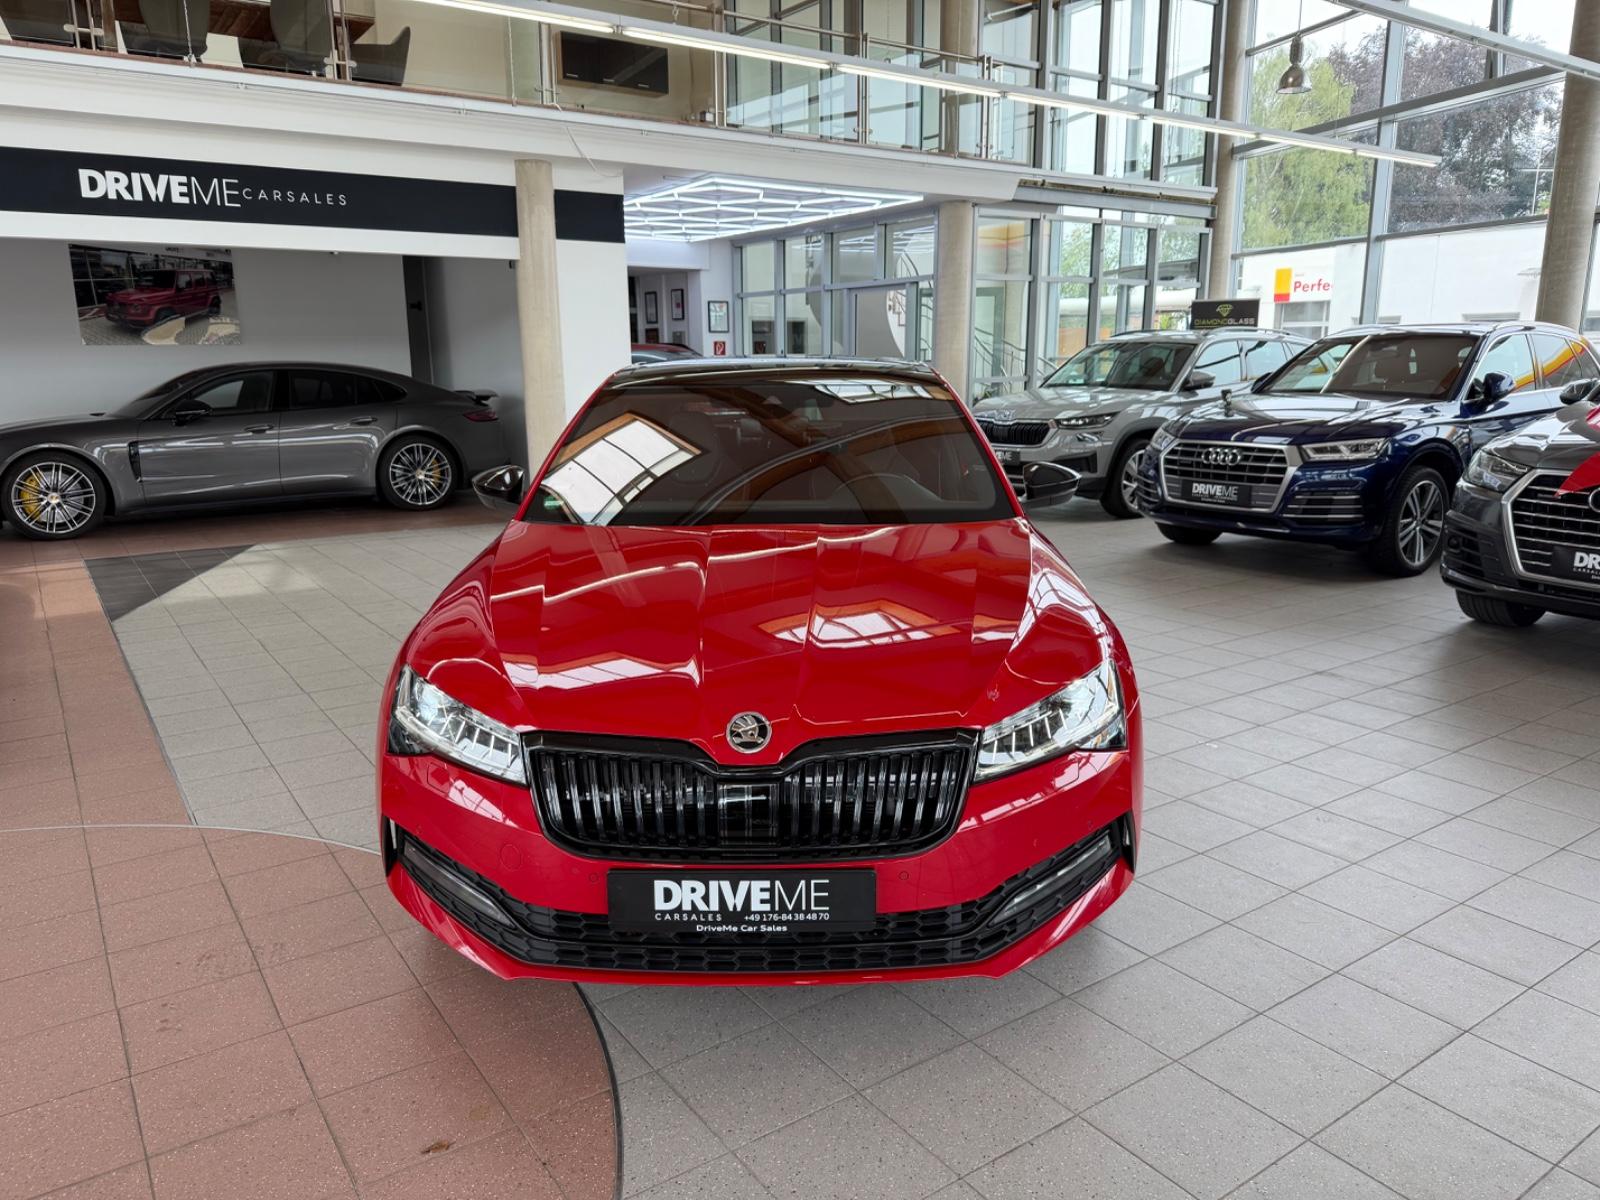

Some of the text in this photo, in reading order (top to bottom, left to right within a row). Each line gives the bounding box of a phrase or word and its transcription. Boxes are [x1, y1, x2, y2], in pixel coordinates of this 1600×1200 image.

[78, 168, 348, 208] DRIVEME CARSALES
[1293, 279, 1334, 293] Perfe
[1191, 482, 1239, 498] DRIVEME
[653, 879, 830, 912] DRIVEME
[654, 912, 722, 921] CARSALES
[696, 924, 788, 932] DriveMe Car Sales
